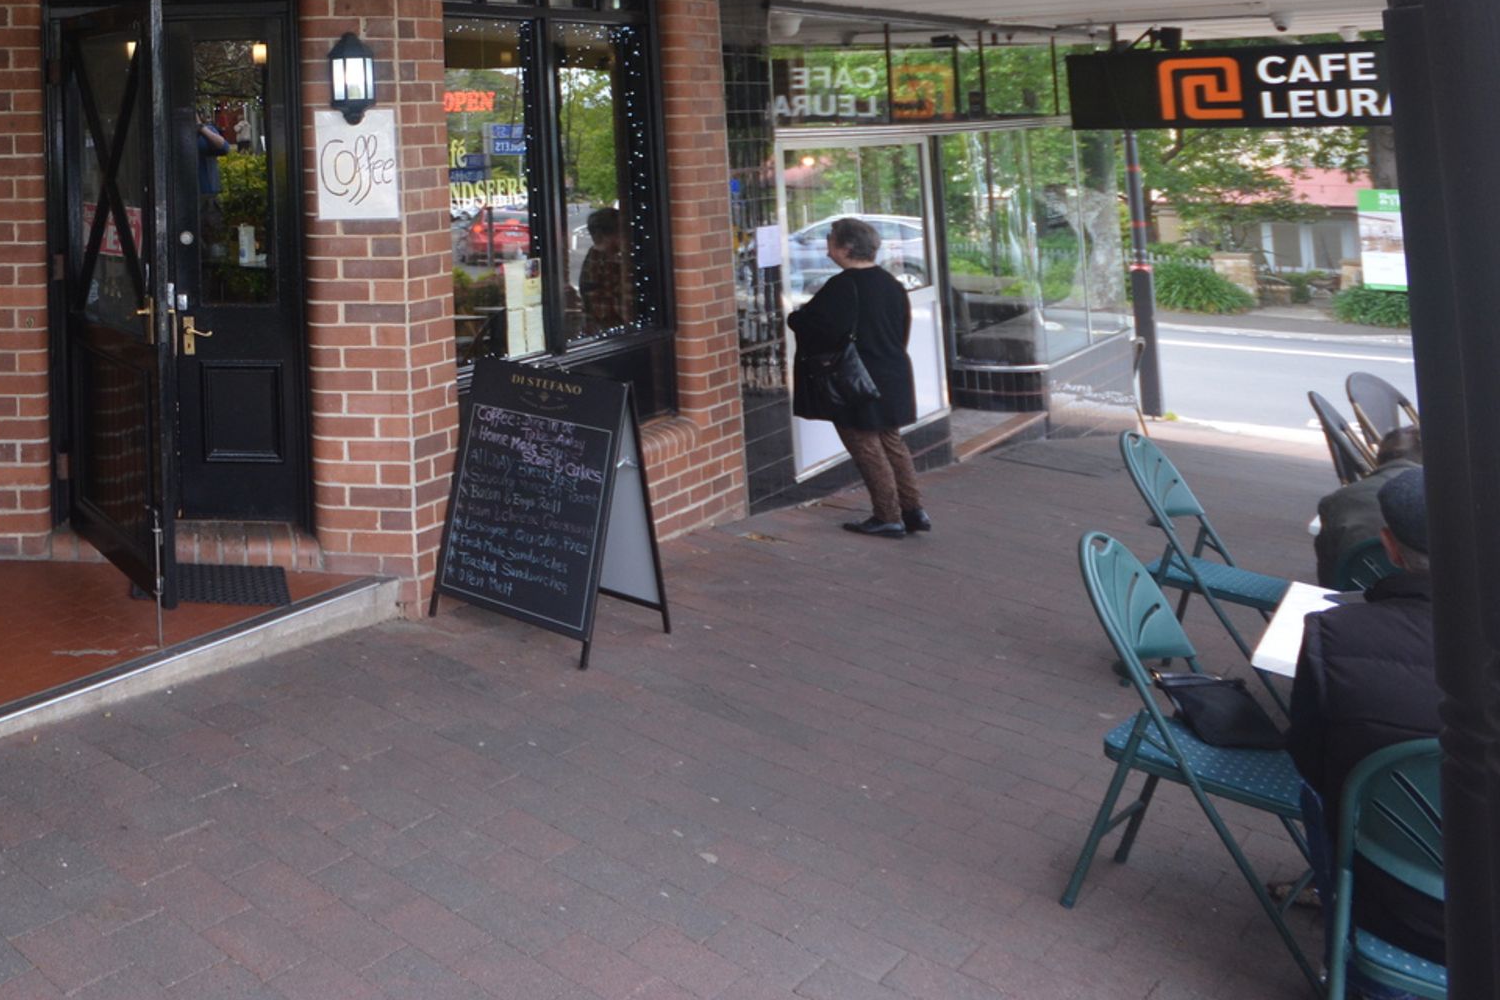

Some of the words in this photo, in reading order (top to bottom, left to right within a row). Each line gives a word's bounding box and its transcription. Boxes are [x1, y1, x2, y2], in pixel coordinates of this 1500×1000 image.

[1256, 52, 1378, 84] CAFE
[443, 91, 496, 112] OPEN
[320, 134, 396, 206] Coffee
